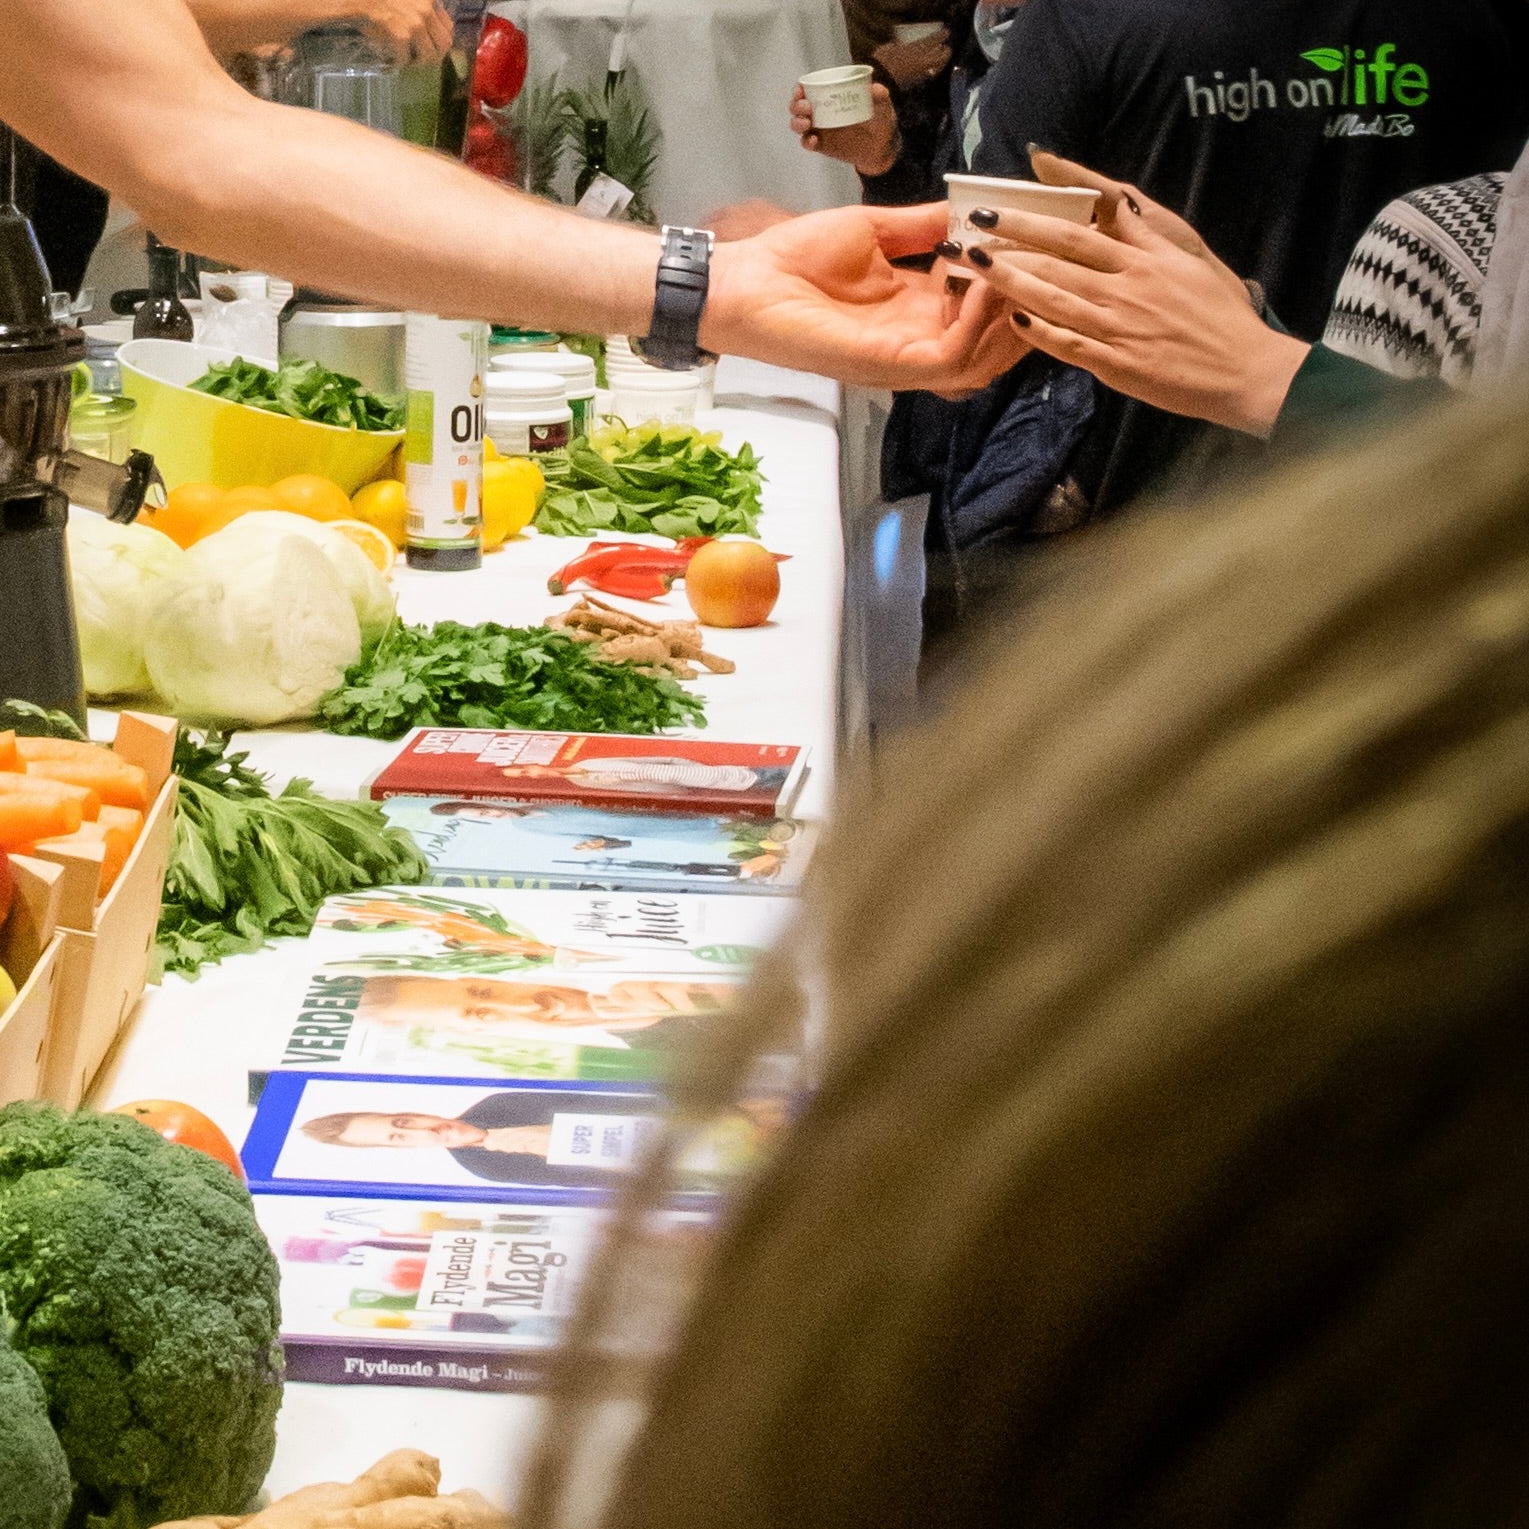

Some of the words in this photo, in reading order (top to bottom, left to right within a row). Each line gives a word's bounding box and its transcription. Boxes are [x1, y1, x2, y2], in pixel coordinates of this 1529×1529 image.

[1184, 67, 1277, 122] high
[1286, 77, 1334, 108] on
[1340, 42, 1430, 106] life
[605, 899, 689, 944] Juice
[280, 975, 368, 1064] VERDENS
[430, 1236, 477, 1307] Flydende
[482, 1240, 567, 1310] Magi
[344, 1357, 434, 1377] Flydende
[438, 1362, 488, 1383] Magi
